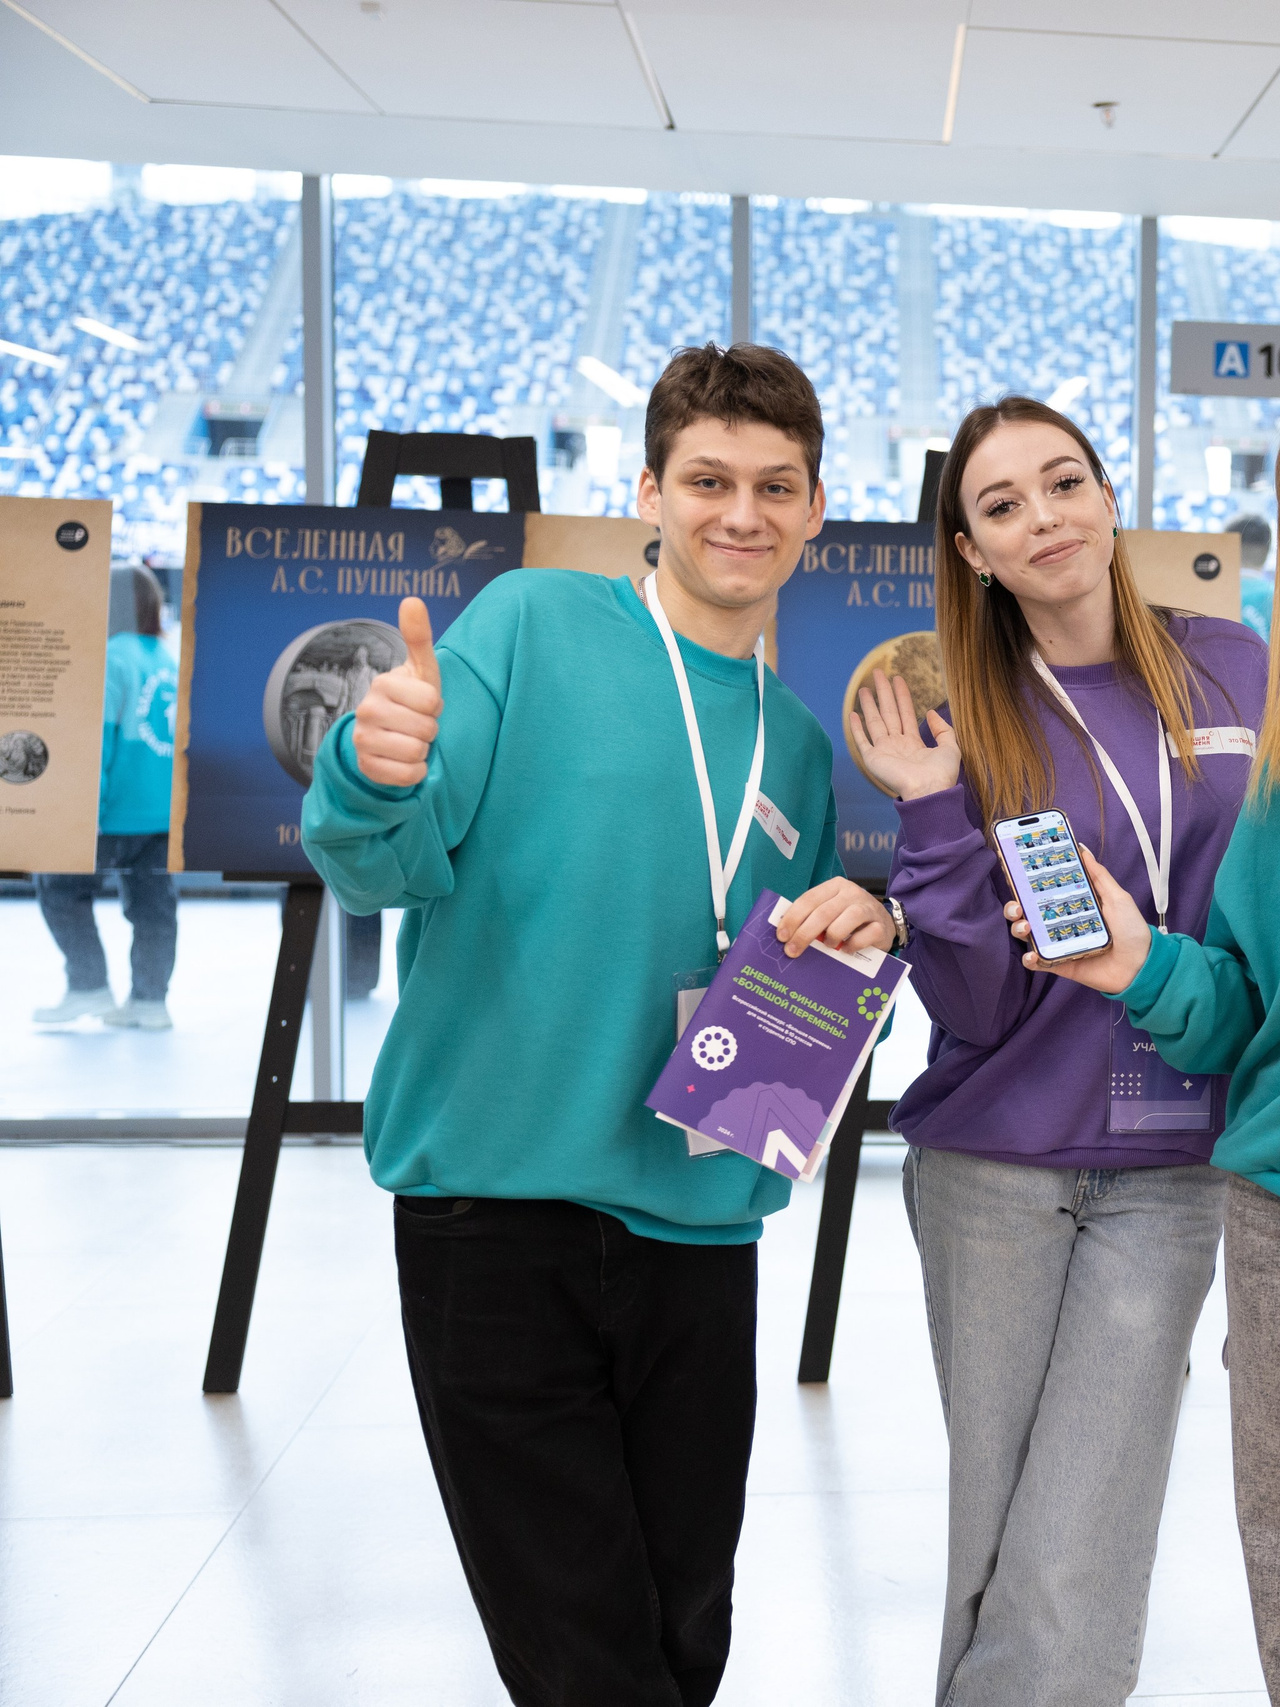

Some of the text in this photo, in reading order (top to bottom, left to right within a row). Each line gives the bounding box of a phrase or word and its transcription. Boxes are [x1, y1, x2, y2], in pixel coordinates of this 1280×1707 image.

[1217, 342, 1247, 376] A
[225, 526, 405, 562] ВСЕЛЕННАЯ
[803, 542, 934, 574] ВСЕЛЕНН
[270, 565, 461, 598] А.С. ПУШКИНА
[847, 580, 900, 608] А.С.
[275, 823, 300, 846] 10
[841, 830, 897, 852] 10 00
[732, 995, 768, 1016] Всероссийский
[733, 977, 847, 1040] «БОЛЬШОЙ ПЕРЕМЕНЫ»
[741, 965, 850, 1028] ДНЕВНИК ФИНАЛИСТА
[784, 1037, 797, 1046] СПО
